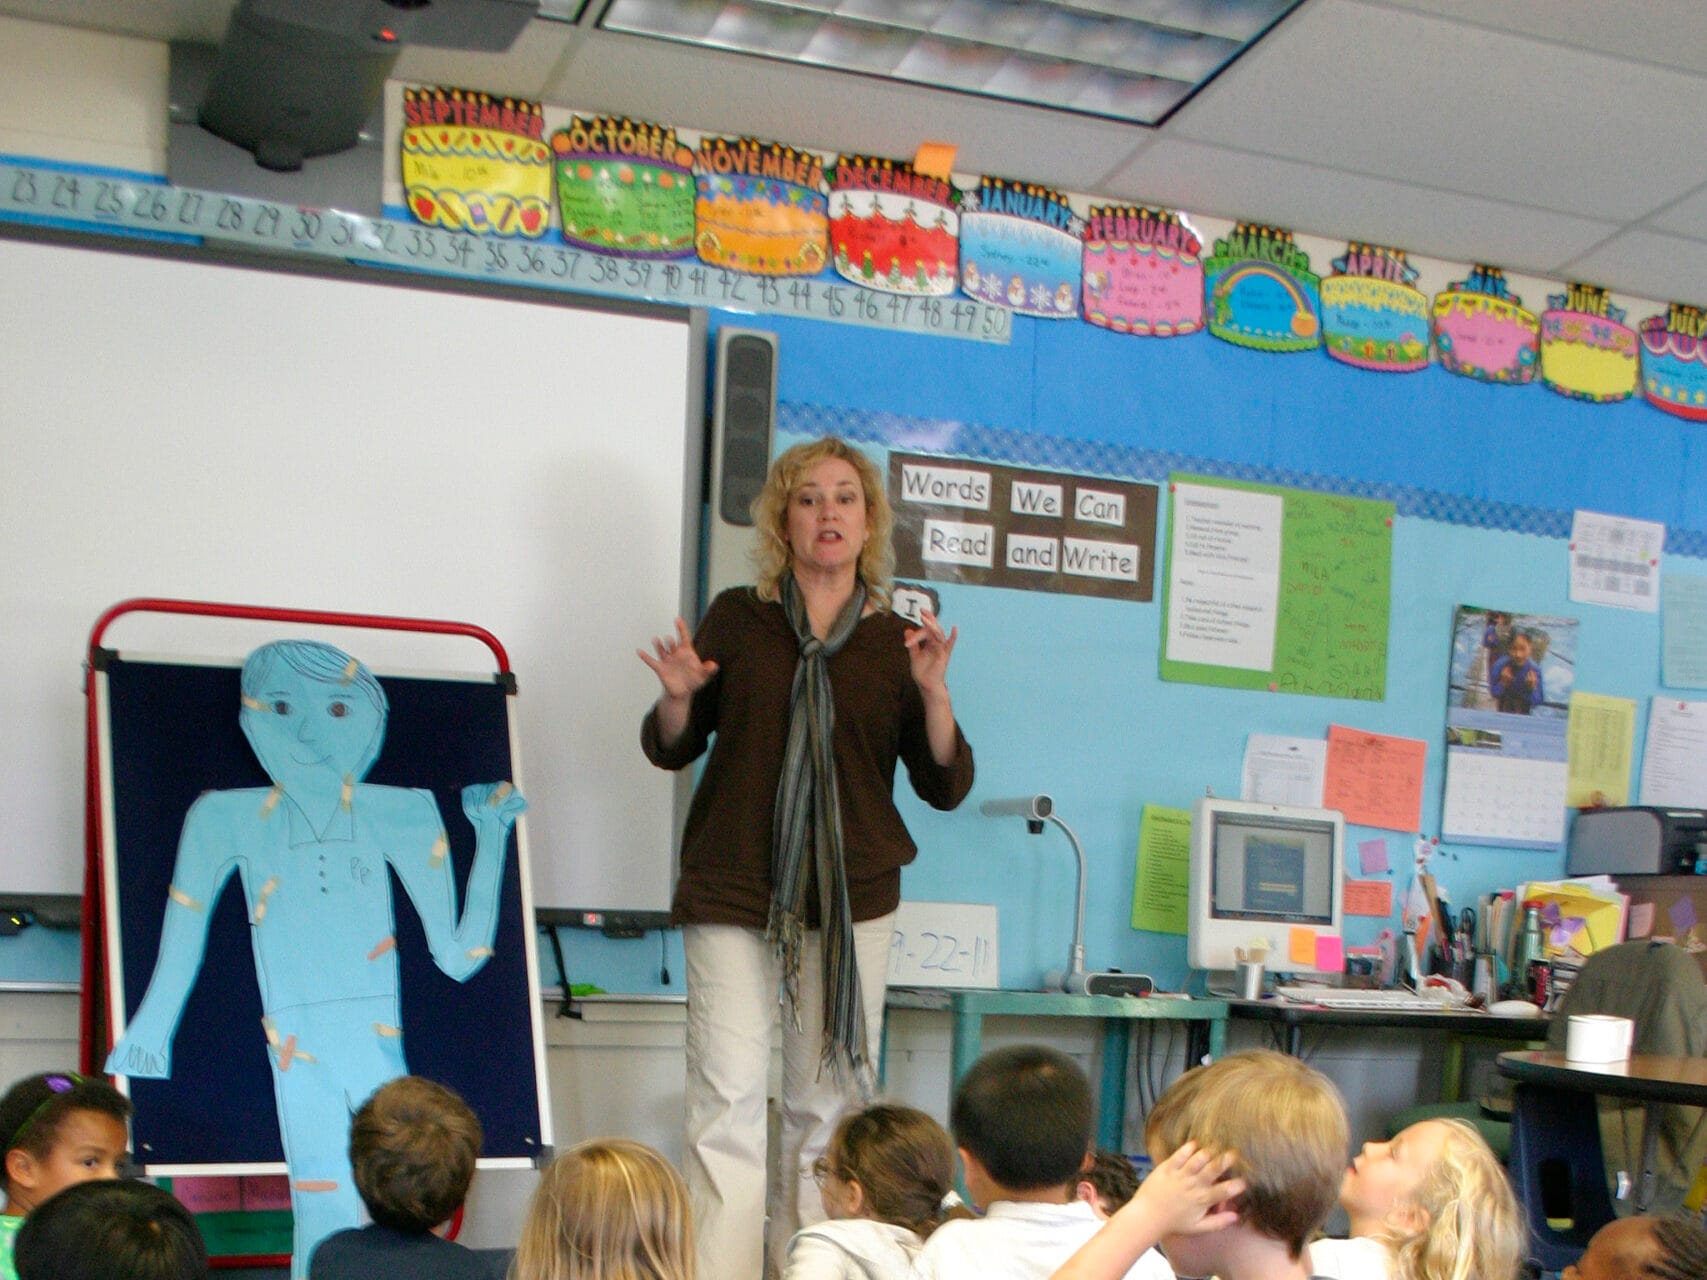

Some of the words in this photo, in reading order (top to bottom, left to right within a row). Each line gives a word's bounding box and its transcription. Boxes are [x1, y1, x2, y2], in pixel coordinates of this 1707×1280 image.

[405, 99, 545, 141] SEPTEMBER
[571, 127, 677, 163] OCTOBER
[697, 149, 824, 192] NOVEMBER
[837, 165, 950, 206] DECEMBER
[980, 187, 1073, 231] JANUARY
[1090, 215, 1194, 250] FEBRUARY
[1227, 231, 1297, 266] MARCH
[12, 169, 37, 204] 23
[51, 175, 81, 209] 24
[94, 180, 123, 213] 25
[133, 188, 166, 221] 26
[179, 192, 203, 224] 27
[217, 199, 243, 231] 28
[253, 204, 281, 236] 29
[291, 212, 322, 240] 30
[329, 215, 354, 246] 31
[363, 221, 398, 254] 32
[404, 228, 436, 258] 33
[443, 235, 475, 268] 34
[483, 240, 509, 270] 35
[515, 245, 545, 273] 36
[550, 250, 581, 280] 37
[589, 255, 619, 283] 38
[623, 259, 653, 288] 39
[662, 263, 682, 295] 40
[688, 267, 707, 296] 41
[718, 270, 745, 301] 42
[757, 274, 780, 306] 43
[788, 280, 812, 310] 44
[822, 285, 847, 317] 45
[854, 288, 878, 320] 46
[886, 294, 911, 324] 47
[919, 295, 942, 328] 48
[951, 301, 977, 332] 49
[982, 305, 1007, 335] 50
[1346, 253, 1406, 285] APRIL
[1564, 289, 1610, 319] JUNE
[1667, 307, 1707, 338] JULY
[904, 469, 986, 503] Words
[1017, 486, 1056, 514] We
[1079, 494, 1120, 520] Can
[930, 528, 988, 557] Read
[1011, 541, 1055, 567] and
[1064, 544, 1133, 574] Write
[904, 598, 917, 618] I
